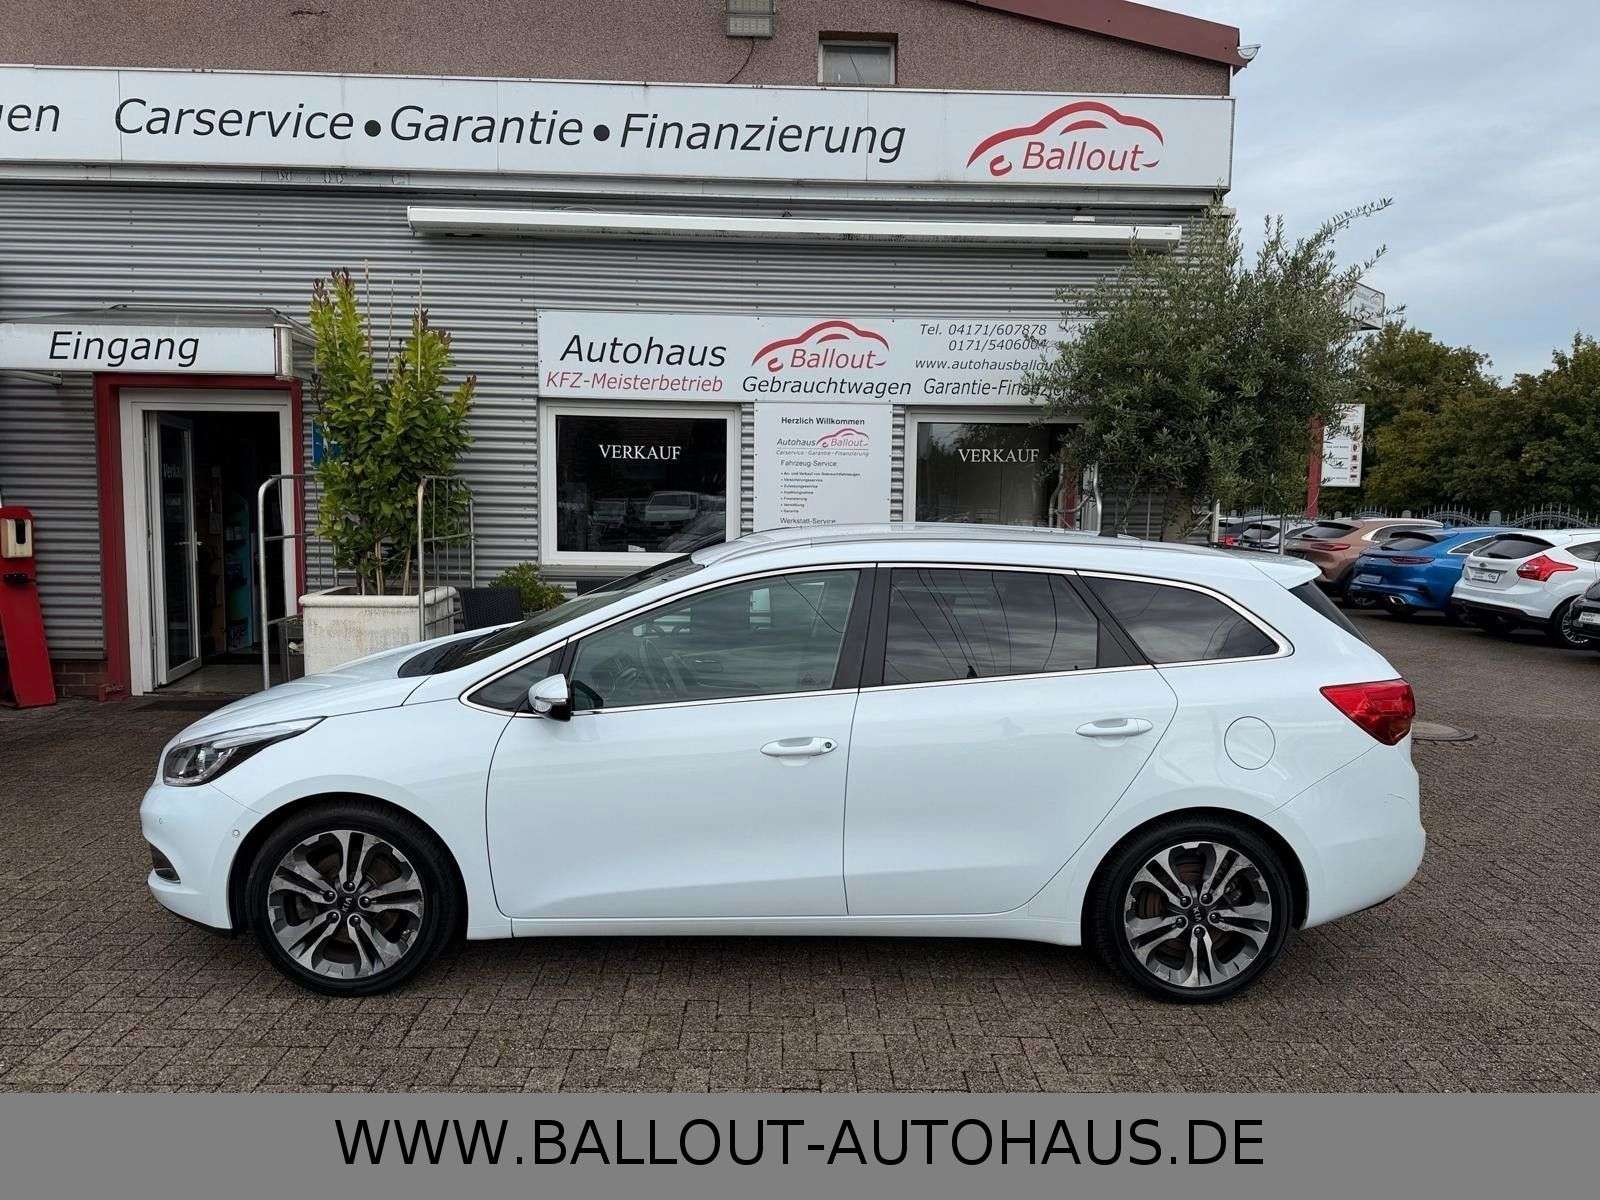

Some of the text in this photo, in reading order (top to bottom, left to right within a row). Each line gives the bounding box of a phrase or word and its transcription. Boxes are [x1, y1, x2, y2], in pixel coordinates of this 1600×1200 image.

[0, 97, 906, 164] en Carservice Garantie Finanzierung
[1022, 140, 1145, 172] Ballout
[920, 323, 1047, 337] Tel. 04171/607878
[49, 330, 200, 368] Eingang
[560, 334, 727, 368] Autohaus
[790, 348, 877, 370] Ballout
[915, 358, 1056, 372] www.autohausballou
[546, 371, 723, 393] KFZ-Meisterbetrieb
[742, 375, 912, 398] Gebrauchtwagen
[781, 416, 865, 426] Herzlich Willkommen
[598, 443, 682, 461] VERKAUF
[776, 438, 863, 447] Autohaus Ballout
[957, 448, 1040, 463] VERKAUF
